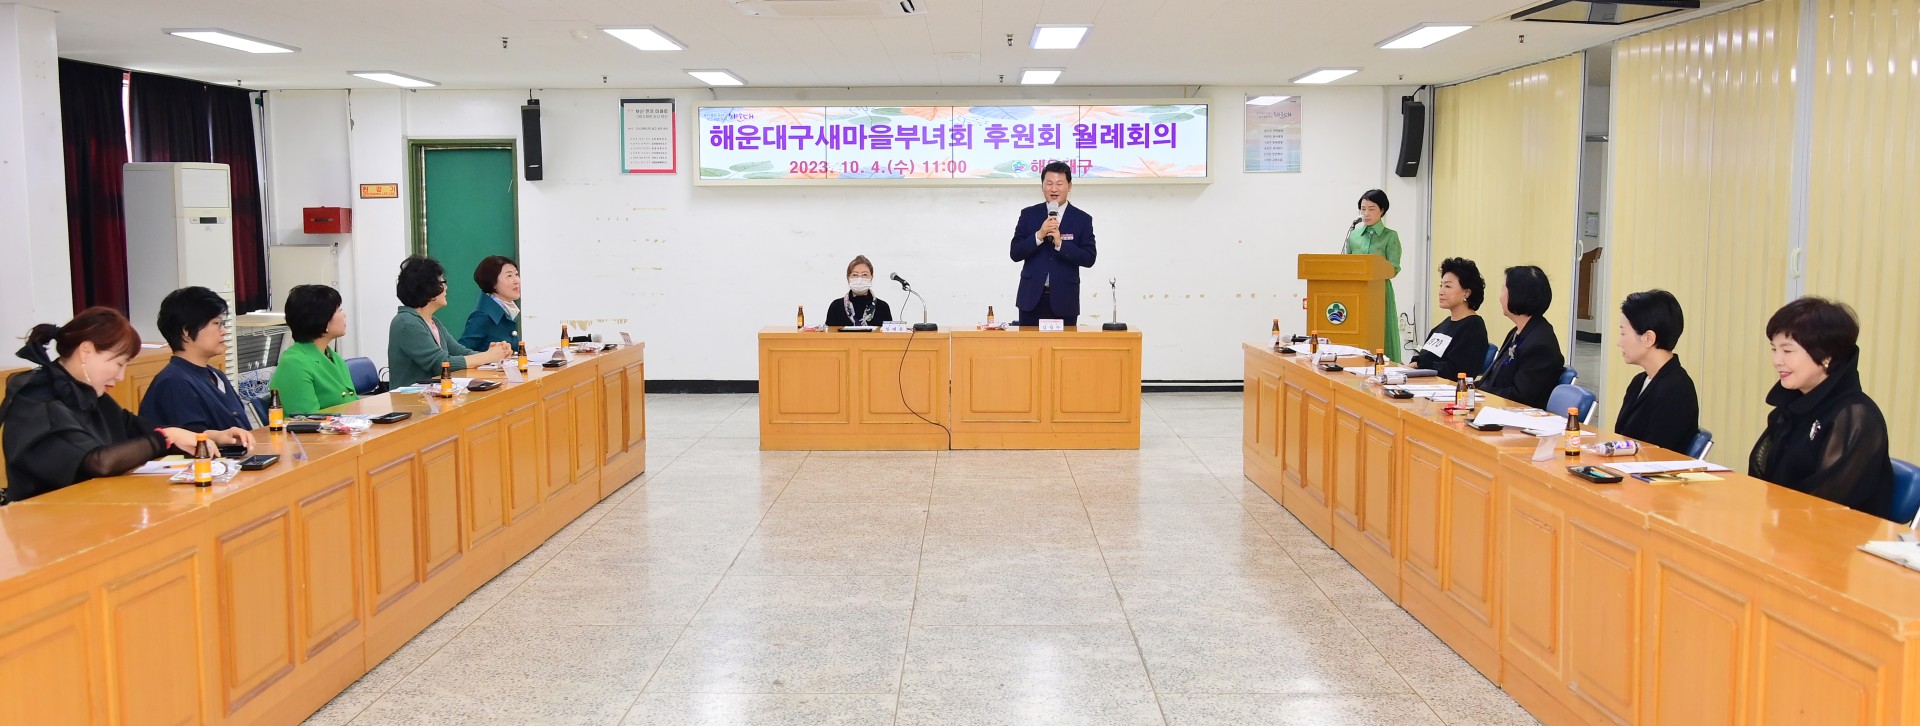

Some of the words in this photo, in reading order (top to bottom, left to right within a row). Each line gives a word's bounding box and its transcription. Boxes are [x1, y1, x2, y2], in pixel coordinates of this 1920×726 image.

[710, 123, 973, 151] 해운대구새마을부녀회
[983, 123, 1061, 150] 후원회
[1072, 122, 1177, 149] 월례회의
[789, 160, 834, 174] 2023.
[841, 160, 865, 174] 10.
[871, 159, 916, 175] 4.(수)
[922, 159, 967, 174] 11:00
[1031, 158, 1094, 174] 해대구
